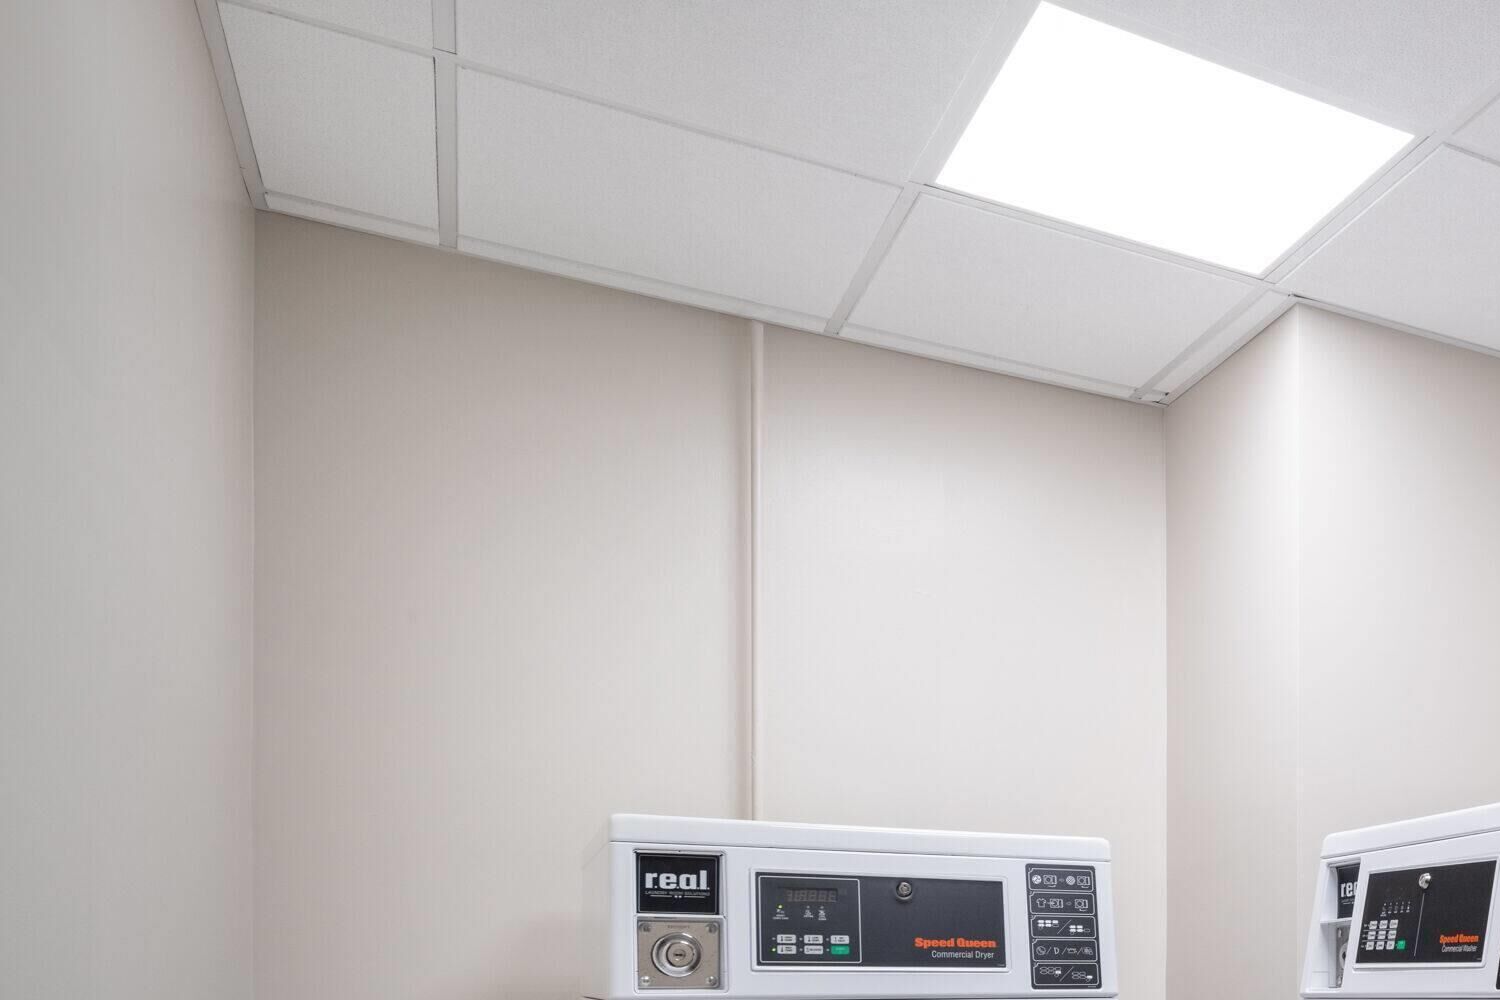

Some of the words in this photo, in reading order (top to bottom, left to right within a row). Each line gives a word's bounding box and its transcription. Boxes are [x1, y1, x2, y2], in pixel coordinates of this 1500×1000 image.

[914, 937, 955, 949] Speed
[957, 938, 997, 948] Queen
[1440, 934, 1459, 944] Speed
[1459, 934, 1479, 943] Queen
[931, 950, 973, 958] Commercial
[975, 951, 994, 960] Dryer
